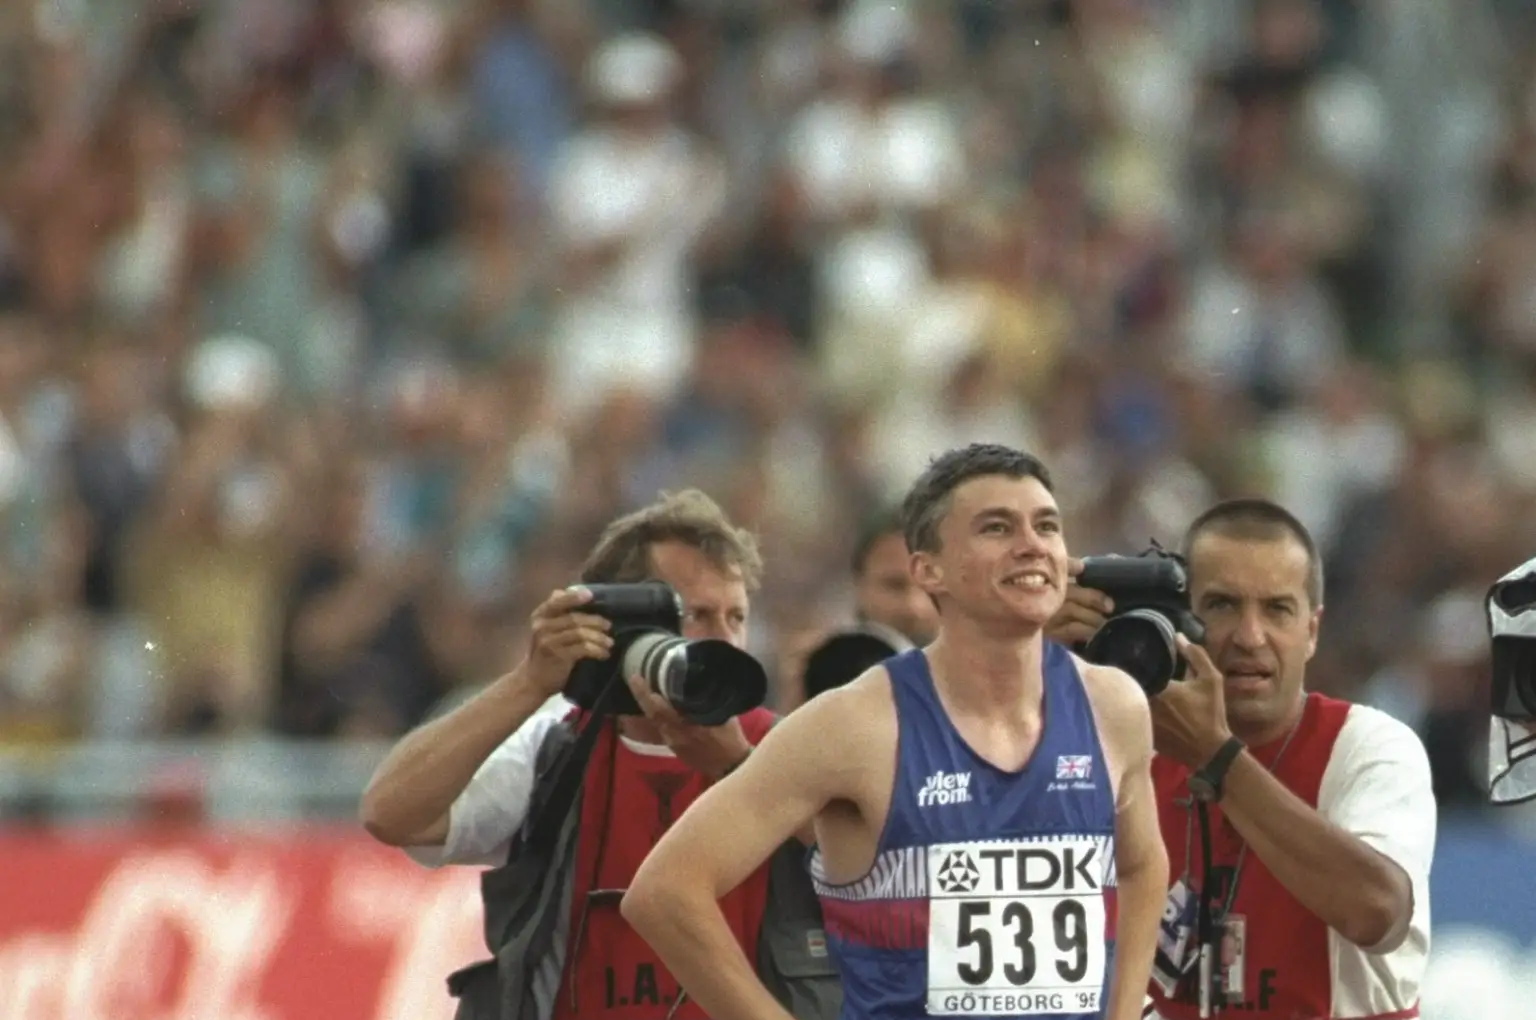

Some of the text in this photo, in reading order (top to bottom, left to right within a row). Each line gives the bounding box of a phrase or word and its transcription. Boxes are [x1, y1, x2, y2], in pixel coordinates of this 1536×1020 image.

[926, 770, 971, 790] view
[979, 847, 1098, 892] TDK
[956, 898, 1088, 986] 539
[944, 993, 1063, 1012] GÖTEBORG
